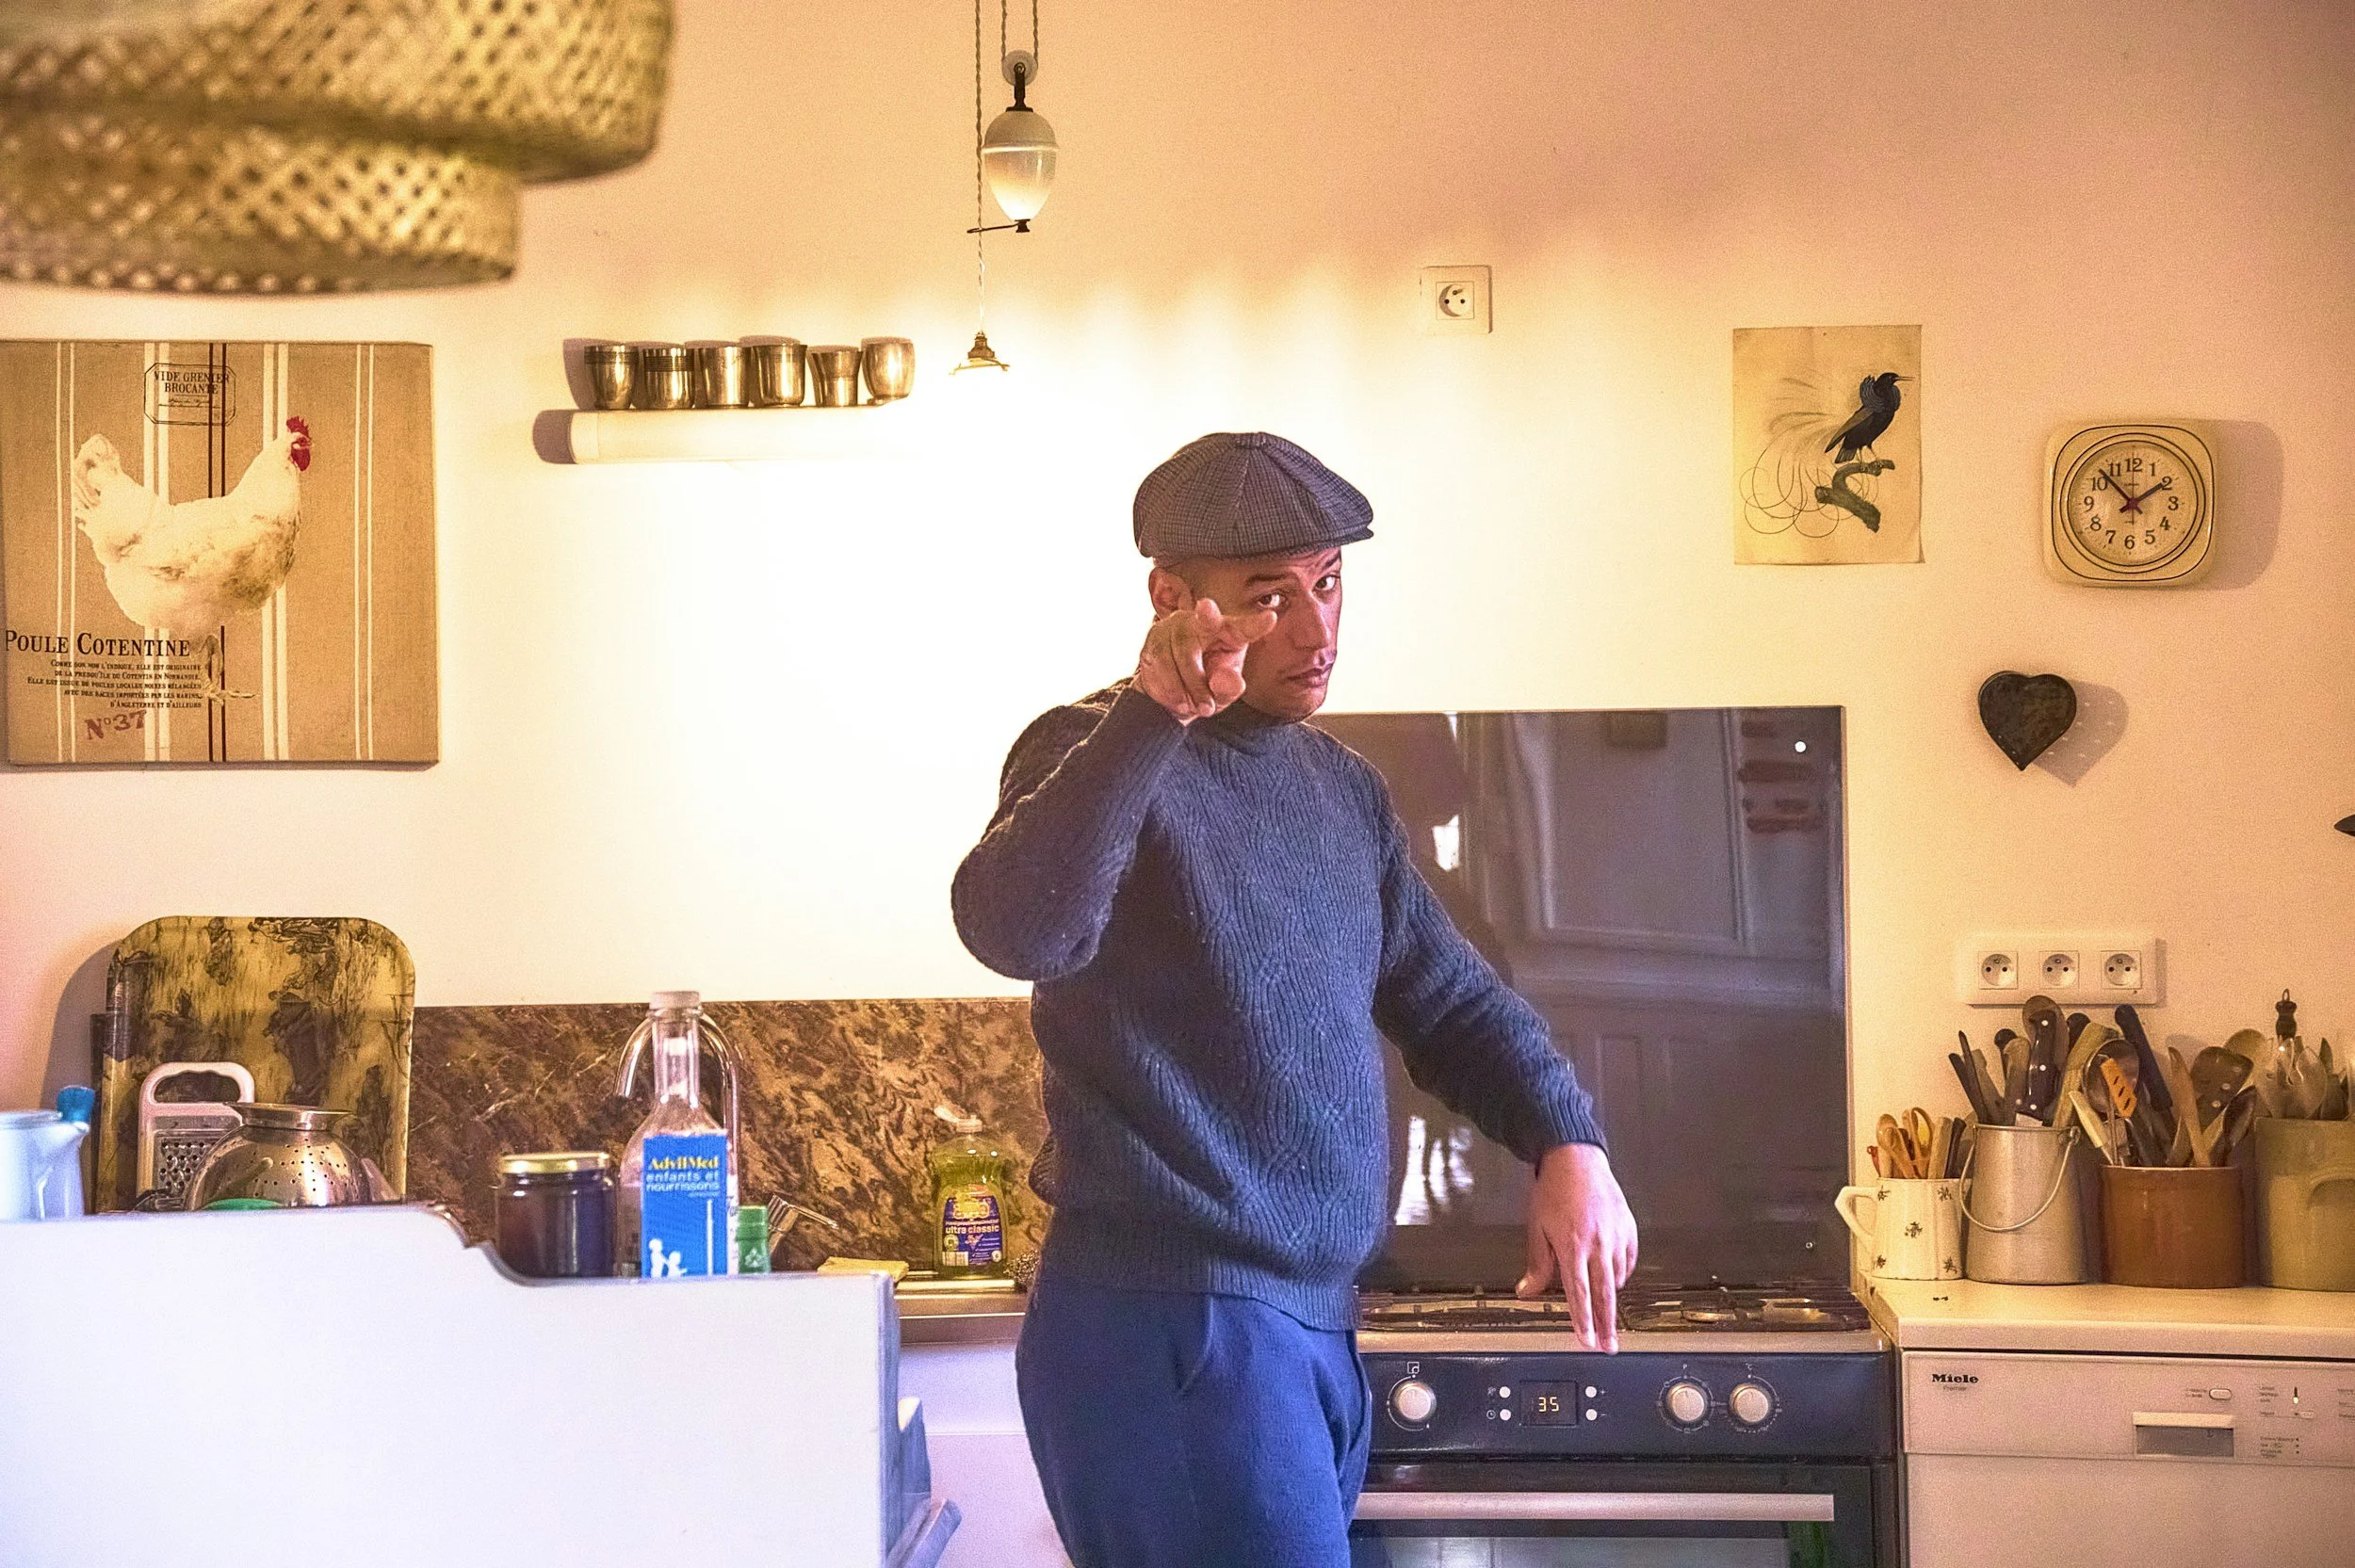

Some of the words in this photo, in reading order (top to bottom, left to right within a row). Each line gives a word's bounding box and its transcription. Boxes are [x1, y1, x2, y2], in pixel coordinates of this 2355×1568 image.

[154, 370, 180, 382] VIDE
[164, 382, 219, 395] BROCANTE
[2108, 462, 2121, 477] 11
[2125, 458, 2142, 472] 12
[2150, 462, 2156, 477] 1
[2091, 477, 2108, 492] 10
[2161, 476, 2172, 491] 2
[2083, 495, 2095, 511] 9
[2168, 495, 2179, 510] 3
[2089, 517, 2102, 531] 8
[2159, 516, 2170, 530] 4
[2104, 530, 2116, 543] 7
[2124, 535, 2136, 549] 6
[2144, 530, 2155, 544] 5
[6, 629, 69, 654] POULE
[76, 632, 190, 657] COTENTINE
[645, 1171, 702, 1183] enfants
[705, 1171, 719, 1183] et
[645, 1181, 720, 1192] nourrissons
[967, 1225, 999, 1234] classic
[1931, 1373, 1979, 1383] Miele
[1538, 1397, 1559, 1413] 35
